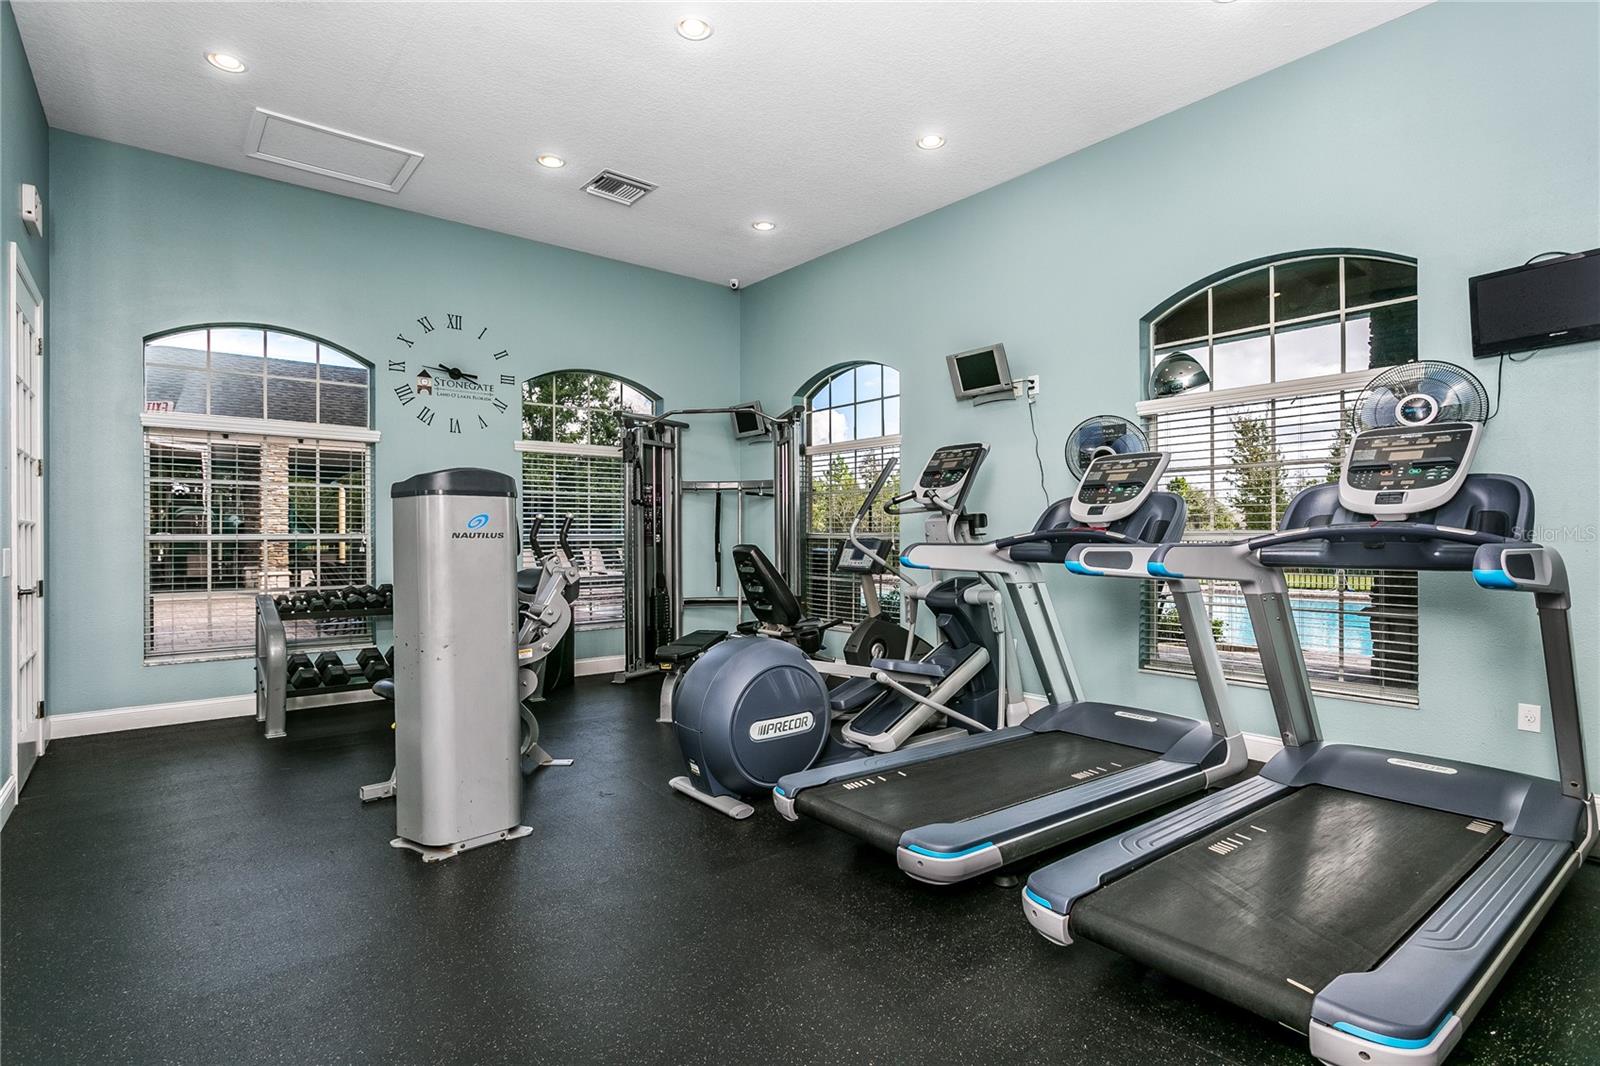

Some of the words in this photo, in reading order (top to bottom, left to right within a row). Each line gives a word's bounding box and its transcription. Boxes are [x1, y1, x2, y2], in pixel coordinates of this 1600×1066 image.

[416, 316, 435, 334] XI
[446, 313, 462, 331] XII
[396, 333, 415, 349] X
[493, 349, 509, 361] II
[388, 359, 406, 373] IX
[433, 376, 495, 392] STONEGATE
[500, 374, 515, 385] III
[394, 383, 416, 406] VIII
[492, 397, 508, 414] IV
[416, 406, 436, 426] VII
[477, 414, 489, 430] V
[449, 417, 462, 434] VI
[763, 716, 809, 735] PRECOR
